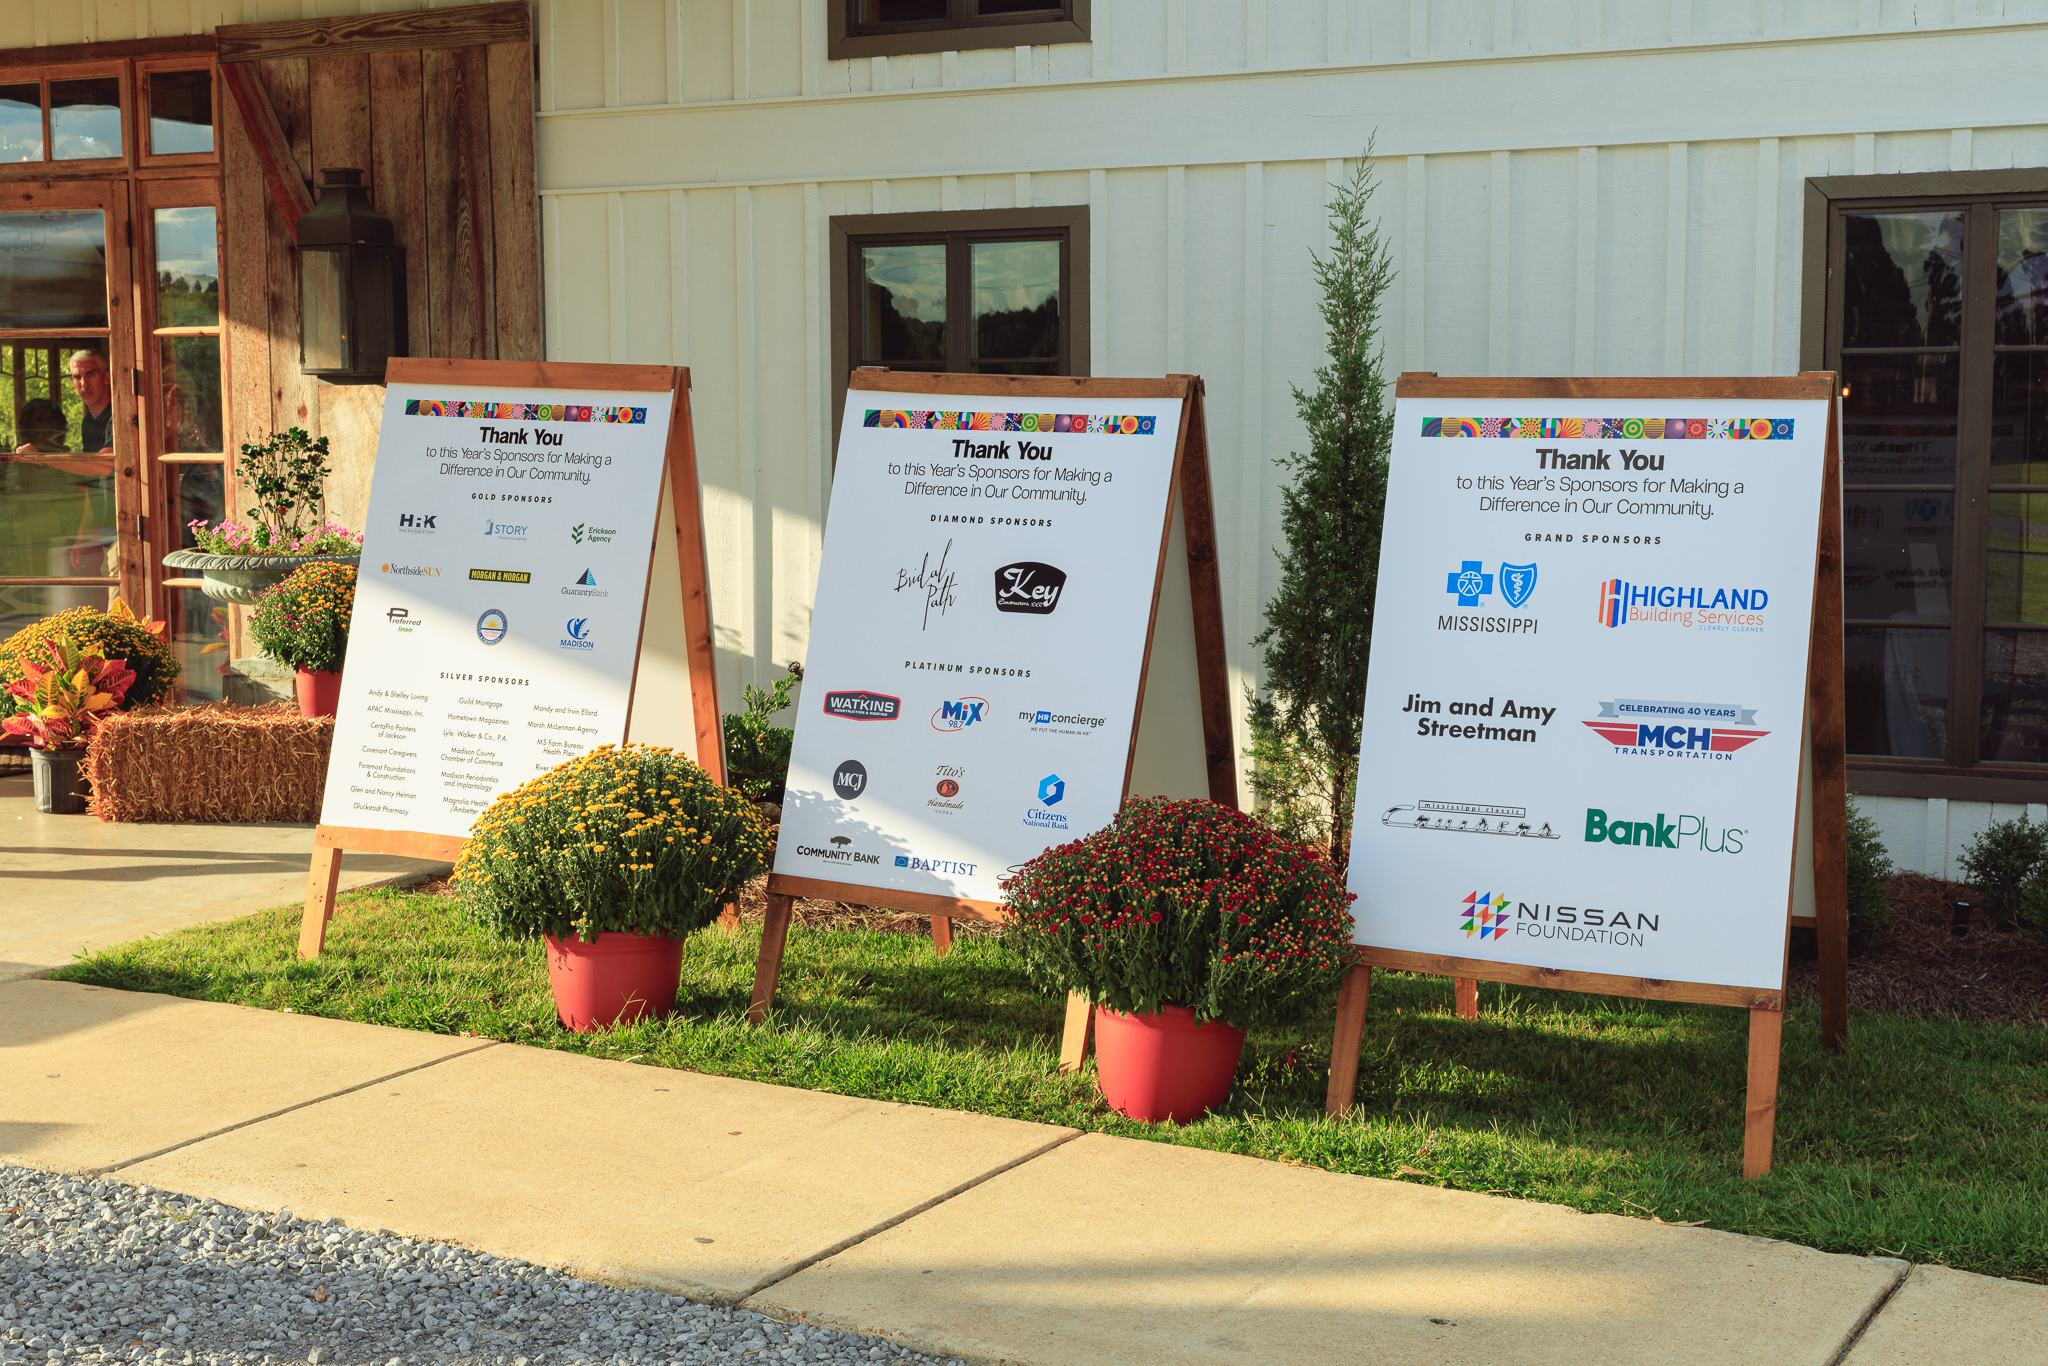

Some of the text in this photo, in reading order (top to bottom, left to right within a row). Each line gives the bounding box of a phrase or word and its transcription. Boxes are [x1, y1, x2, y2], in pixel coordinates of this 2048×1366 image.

[480, 427, 563, 446] Thank You
[952, 440, 1052, 460] Thank You
[426, 446, 611, 468] to this Year's Sponsors for Making a
[1536, 449, 1664, 470] Thank You
[440, 463, 591, 485] Difference in Our Community.
[889, 462, 1112, 486] to this Year's Sponsors for Making a
[905, 482, 1086, 505] Difference in Our Community.
[1457, 476, 1744, 498] to this Year's Sponsors for Making a
[501, 495, 552, 503] SPONSORS
[1480, 497, 1713, 520] Difference in Our Community.
[931, 515, 1052, 527] DIAMOND SPONSORS
[588, 527, 616, 536] Erickson
[588, 535, 611, 544] Agency
[1525, 534, 1660, 544] GRAND SPONSORS
[894, 539, 952, 592] Bridal
[471, 569, 529, 583] MORGAN MORGAN
[999, 568, 1059, 607] Key
[923, 572, 958, 631] Path
[1631, 585, 1769, 611] HIGHLAND
[386, 607, 422, 626] Preferred
[1630, 607, 1763, 627] Building Services
[1438, 615, 1538, 634] MISSISSIPPI
[560, 639, 594, 649] MADISON
[905, 661, 1030, 677] PLATINUM SPONSORS
[440, 672, 529, 686] SILVER SPONSORS
[368, 689, 428, 702] Andy Shelley Loving
[459, 697, 502, 709] Guild Mortgage
[830, 697, 894, 713] WATKINS
[1402, 694, 1556, 725] Jim and Amy
[384, 708, 413, 716] Mississippi,
[533, 704, 553, 714] Mandy
[581, 708, 598, 716] Ellard
[1619, 704, 1684, 714] CELEBRATING
[1704, 709, 1736, 717] YEARS
[448, 713, 509, 725] Hometown Magazines
[948, 720, 964, 729] 98.7
[371, 722, 416, 732] CertaPro Painters
[547, 722, 575, 731] McLennan
[576, 726, 598, 735] Agency
[1417, 718, 1536, 742] Streetman
[1637, 724, 1711, 751] MCH
[564, 741, 584, 749] Bureau
[362, 746, 417, 758] Covenant Caregivers
[451, 747, 496, 759] Madison County
[563, 750, 576, 758] Plan
[1615, 747, 1732, 760] TRANSPORTATION
[441, 754, 466, 762] Chamber
[474, 757, 503, 766] Commerce
[359, 762, 415, 774] Foremost Foundations
[536, 763, 549, 771] River
[936, 765, 966, 778] Tito's
[373, 772, 405, 781] Construction
[441, 771, 498, 783] Madison Periodontics
[837, 772, 864, 791] MCJ
[457, 781, 492, 792] Implantology
[377, 789, 394, 798] Nancy
[396, 791, 416, 799] Helman
[353, 802, 408, 816] Gluckstadt Pharmacy
[443, 797, 489, 808] Magnolia Health
[927, 798, 964, 810] Handmade
[1424, 802, 1521, 815] mississippi classic
[1027, 808, 1067, 823] Citizens
[1023, 819, 1068, 830] National Bank
[797, 846, 852, 860] COMMUNITY
[854, 852, 880, 864] BANK
[911, 857, 977, 876] BAPTIST
[1517, 902, 1659, 932] NISSAN
[1516, 922, 1644, 948] FOUNDATION
